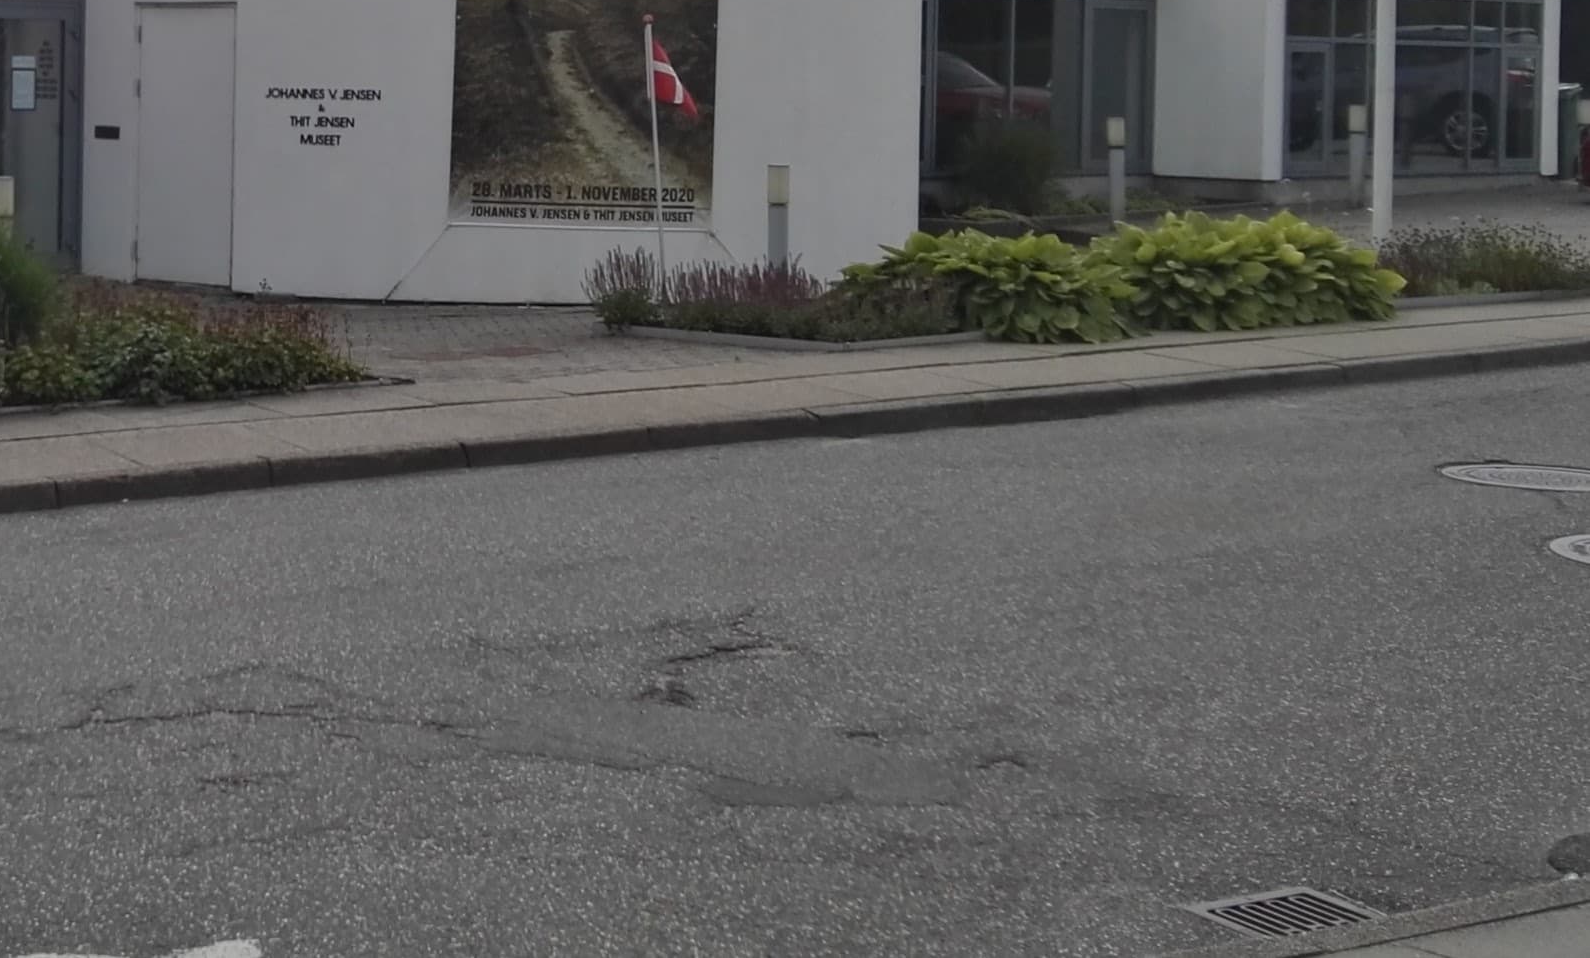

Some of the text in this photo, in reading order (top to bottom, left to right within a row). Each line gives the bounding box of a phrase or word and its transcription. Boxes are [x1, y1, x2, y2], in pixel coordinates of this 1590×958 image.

[266, 87, 325, 100] JOHANNES
[340, 89, 382, 101] JENSEN
[318, 103, 325, 112] &
[290, 115, 355, 128] THIT JENSEN
[300, 134, 341, 146] MUSEET
[471, 182, 495, 198] 28.
[500, 184, 552, 200] MARTS
[566, 185, 577, 201] 1.
[581, 185, 658, 202] NOVEMBER
[661, 187, 695, 203] 2020
[471, 205, 527, 219] JOHANNES
[529, 207, 539, 219] V.
[542, 207, 581, 220] JENSEN
[583, 209, 590, 220] &
[593, 209, 615, 221] THIT
[618, 209, 655, 222] JENSEN
